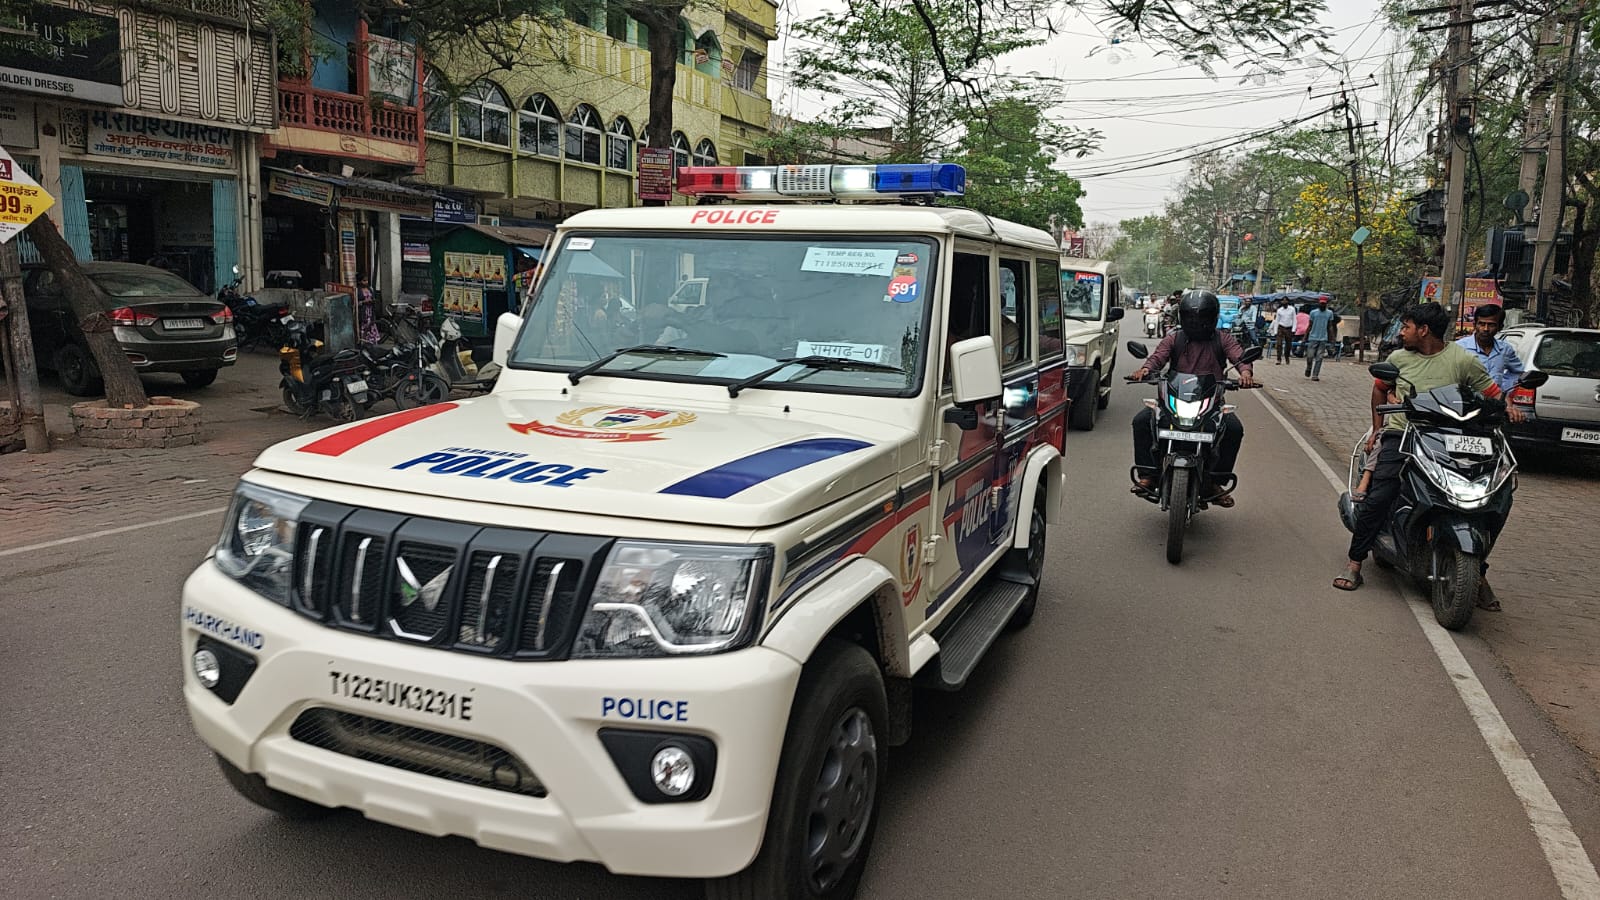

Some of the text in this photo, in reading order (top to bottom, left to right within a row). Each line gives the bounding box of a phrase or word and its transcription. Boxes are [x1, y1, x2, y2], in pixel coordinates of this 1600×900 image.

[34, 78, 74, 93] DRESSES
[690, 210, 780, 224] POLICE
[890, 283, 917, 296] 591
[1455, 443, 1487, 454] P4253
[1458, 437, 1482, 445] JH24
[391, 452, 608, 487] POLICE
[959, 485, 993, 543] POLICE
[328, 671, 472, 721] T1225UK3231E
[602, 697, 688, 721] POLICE
